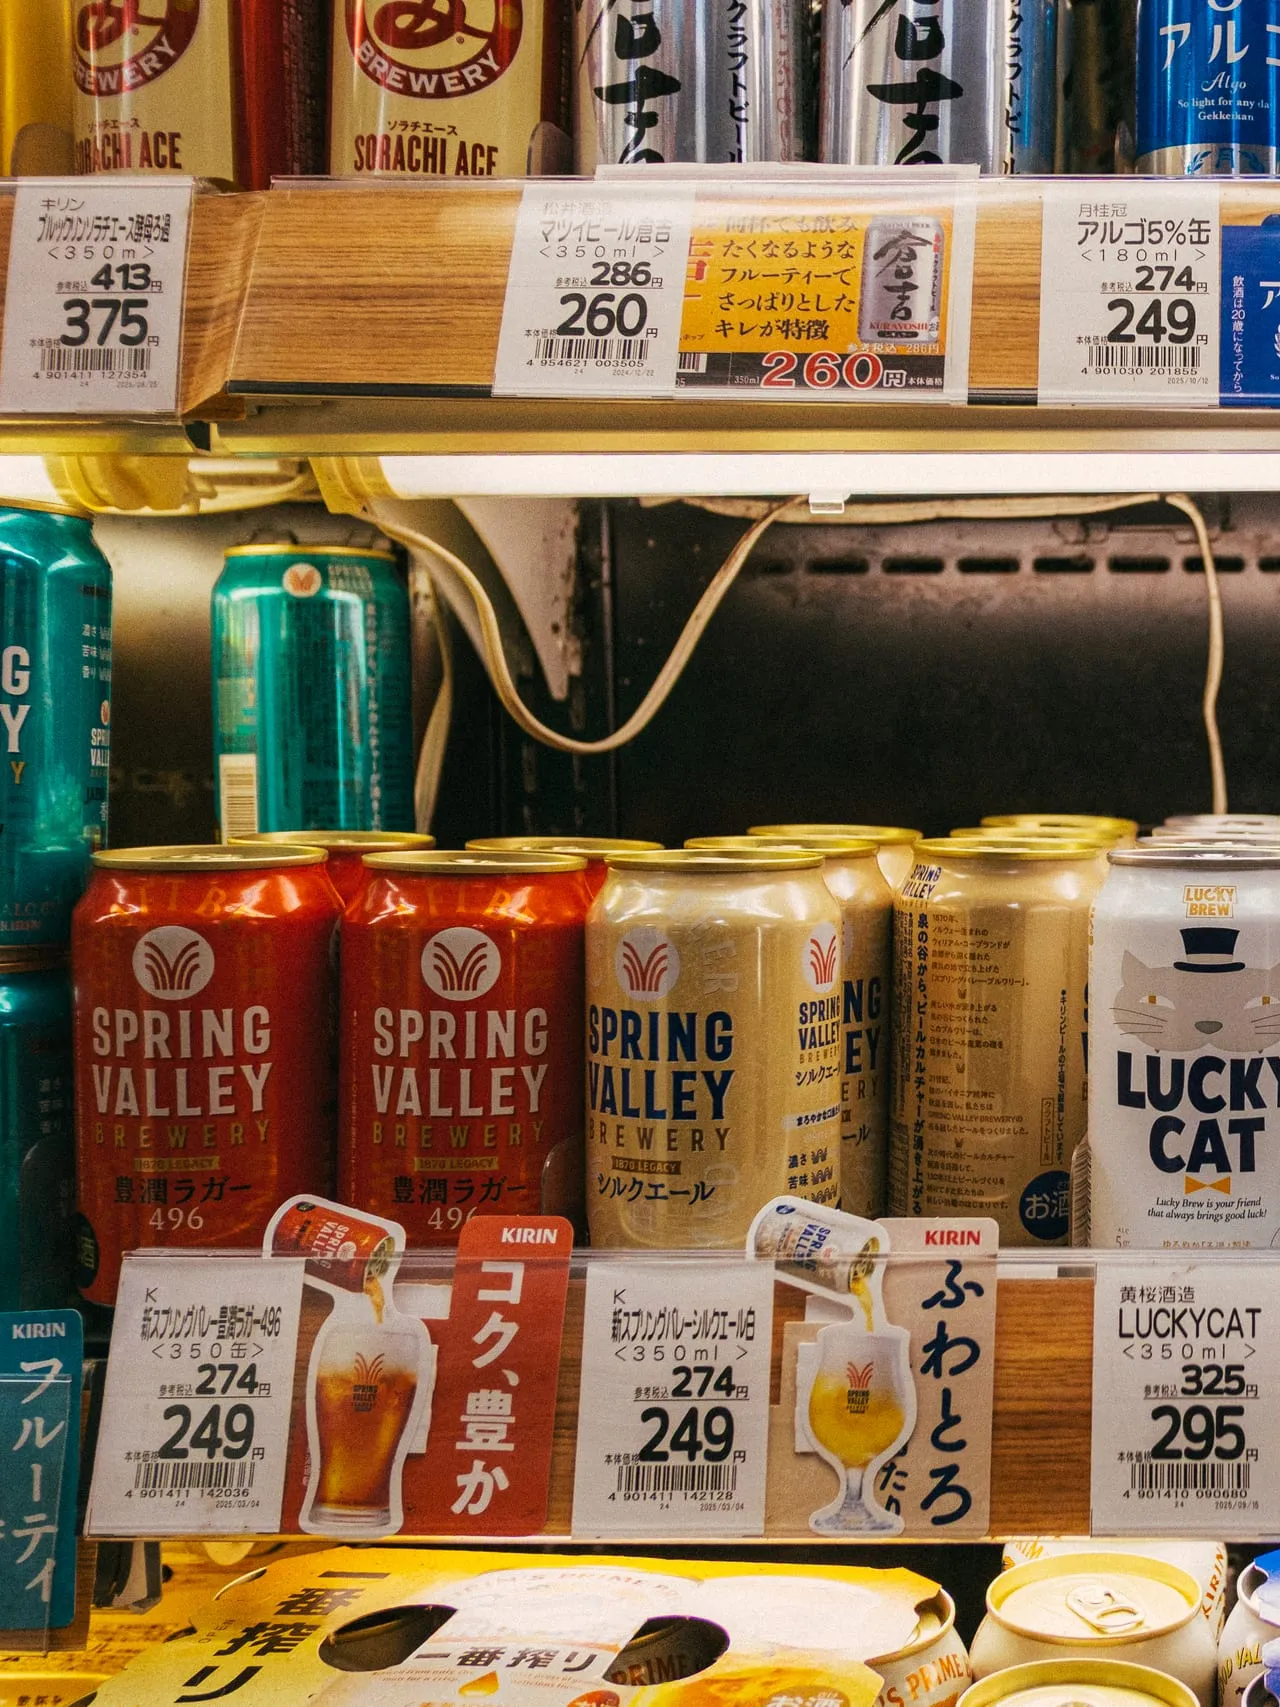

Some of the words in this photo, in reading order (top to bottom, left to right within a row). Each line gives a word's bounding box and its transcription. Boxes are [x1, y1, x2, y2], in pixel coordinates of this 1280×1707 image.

[358, 39, 501, 94] BREWERY
[1201, 72, 1246, 93] Algo
[1192, 98, 1215, 108] light
[1237, 99, 1254, 108] any
[387, 120, 458, 136] ソラチエース
[139, 131, 183, 169] ACE
[354, 133, 447, 175] SORACHI
[40, 198, 85, 211] キリン
[1078, 203, 1127, 217] 月桂冠
[1078, 218, 1210, 246] アルゴ5%缶
[722, 241, 857, 260] たくなるような
[720, 265, 857, 286] フルーティーで
[718, 292, 857, 313] さっぱりとした
[715, 319, 830, 340] キレが特徴
[1185, 886, 1236, 902] LUCKY
[1189, 903, 1231, 916] BREW
[92, 1005, 271, 1059] SPRING
[373, 1007, 549, 1059] SPRING
[589, 1004, 733, 1062] SPRING
[92, 1062, 273, 1117] VALLEY
[371, 1063, 549, 1117] VALLEY
[588, 1061, 735, 1120] VALLEY
[95, 1119, 270, 1148] BREWERY
[372, 1120, 546, 1148] BREWERY
[589, 1119, 731, 1151] BREWERY
[1149, 1115, 1266, 1174] CAT
[615, 1158, 635, 1170] 1870
[638, 1160, 677, 1173] LEGACY
[114, 1176, 252, 1205] 豊潤ラガー
[393, 1176, 526, 1204] 豊潤ラガー
[598, 1175, 715, 1205] シルクエール
[788, 1173, 808, 1189] 苦味
[1147, 1208, 1164, 1218] that
[1165, 1209, 1195, 1222] always
[1196, 1211, 1223, 1222] brings
[1225, 1210, 1246, 1222] good
[1247, 1208, 1267, 1219] luck!
[1156, 1197, 1181, 1210] Lucky
[1182, 1199, 1204, 1208] Brew
[1207, 1199, 1214, 1207] is
[1215, 1200, 1235, 1210] your
[1236, 1197, 1262, 1209] friend
[149, 1206, 204, 1230] 496
[502, 1227, 557, 1244] KIRIN
[925, 1230, 981, 1245] KIRIN
[145, 1287, 158, 1303] K
[614, 1288, 627, 1304] K
[1120, 1286, 1195, 1304] 黄桜酒造
[12, 1322, 65, 1339] KIRIN
[1118, 1307, 1262, 1339] LUCKYCAT
[450, 1261, 525, 1516] コク、豊か
[920, 1259, 984, 1526] ふわとろ
[175, 1570, 391, 1703] 一番搾り
[415, 1647, 598, 1673] 一番搾り
[905, 1653, 964, 1699] PRIME
